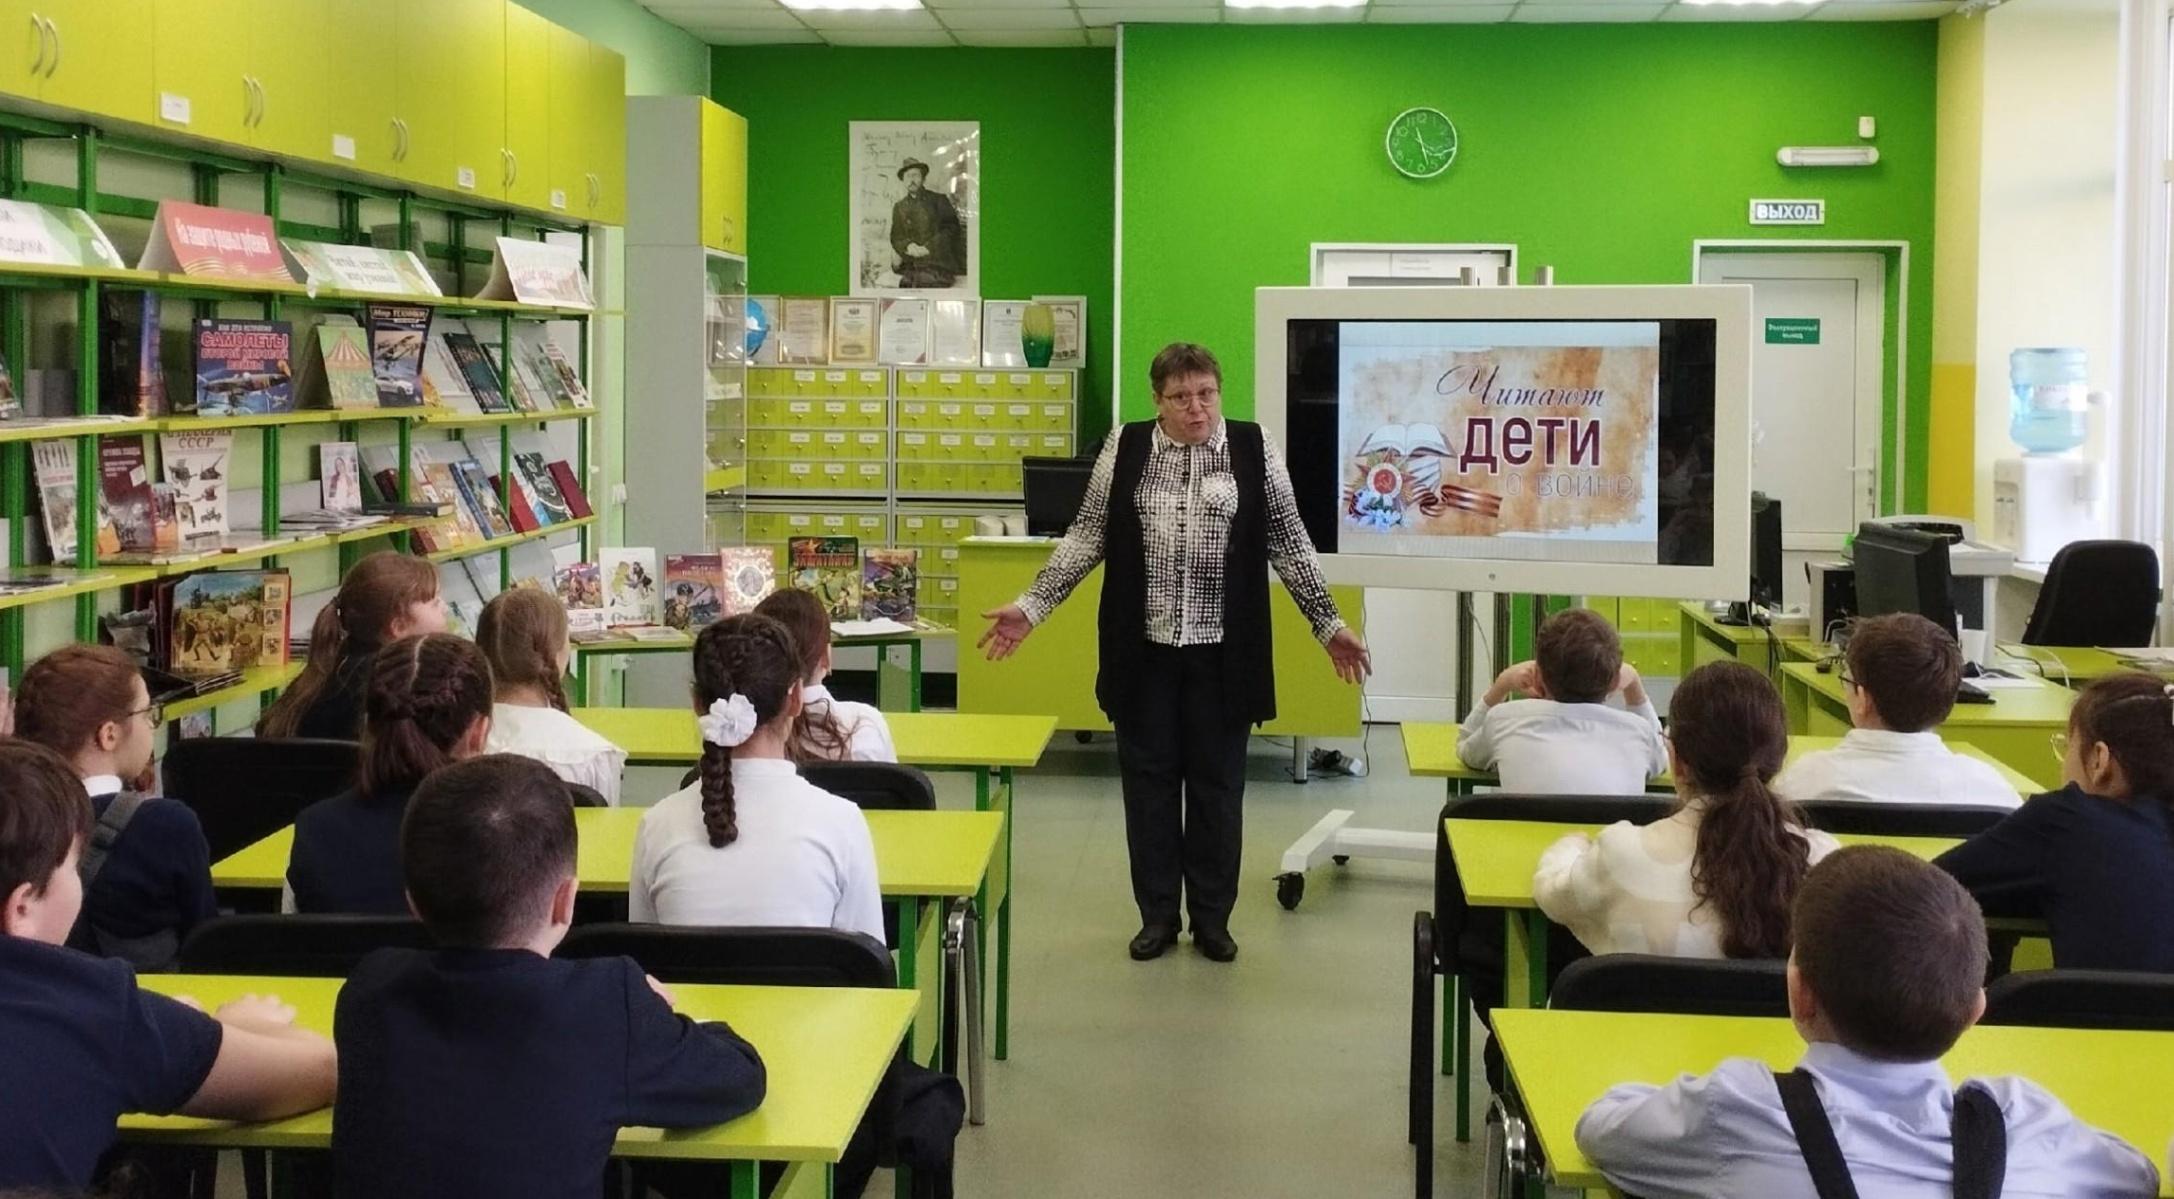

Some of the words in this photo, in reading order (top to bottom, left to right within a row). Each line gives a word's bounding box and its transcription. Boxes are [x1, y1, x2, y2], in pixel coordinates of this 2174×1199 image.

[1756, 204, 1817, 220] ВЫХОД
[201, 330, 289, 349] САМОЛЕТЫ
[201, 347, 241, 359] ВТОРОЙ
[241, 347, 288, 359] МИРОВОЙ
[226, 359, 265, 370] ВОЙНЫ
[1436, 364, 1607, 407] Читают
[178, 437, 214, 449] СССР
[1458, 416, 1602, 475] дети
[1536, 467, 1635, 498] войне
